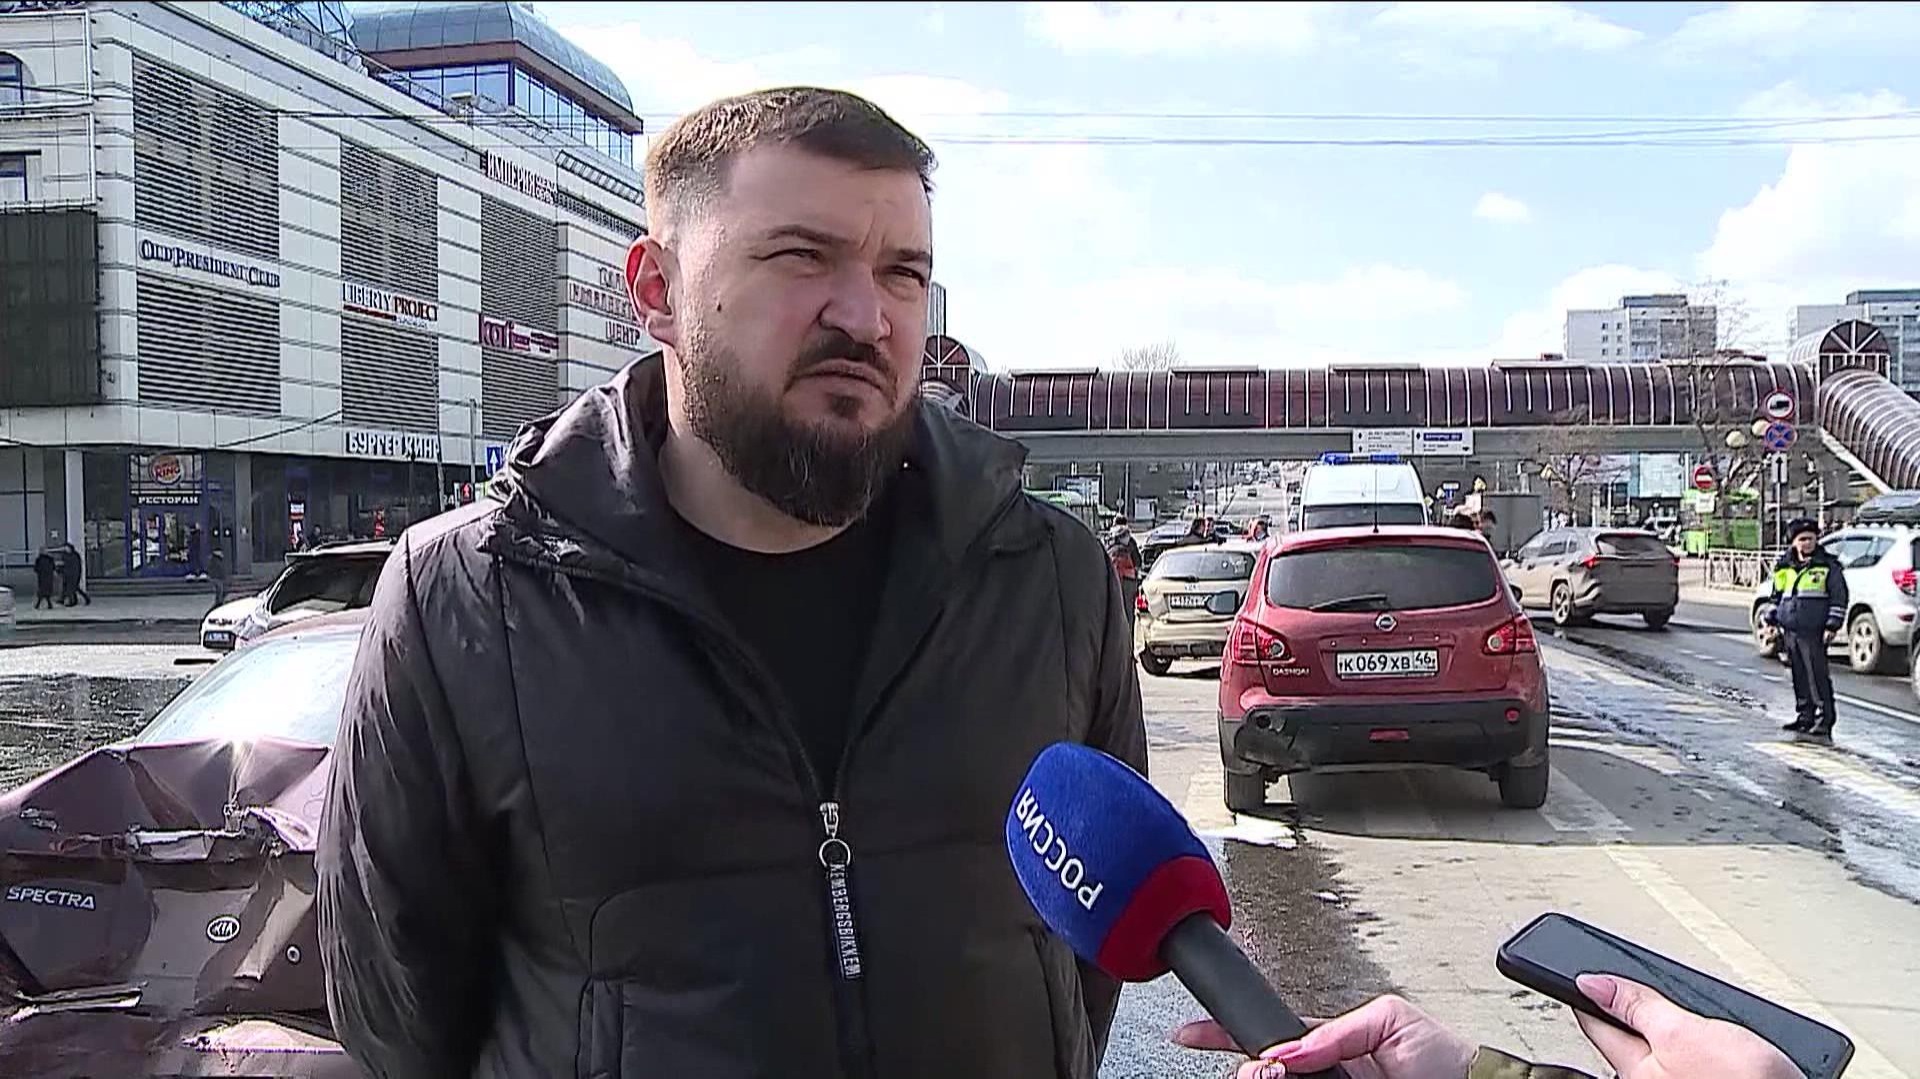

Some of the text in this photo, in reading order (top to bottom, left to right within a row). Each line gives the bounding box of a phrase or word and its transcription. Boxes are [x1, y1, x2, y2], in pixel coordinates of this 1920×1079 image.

[487, 150, 536, 196] ИМПЕРИЯ
[139, 239, 280, 288] OLD PRESIDENT CLUB
[343, 282, 438, 322] LIBERTY PROJECT
[605, 321, 641, 345] ЦЕНТР
[347, 432, 400, 456] БУРГЕР
[138, 496, 199, 505] РЕСТОРАН
[1415, 652, 1432, 664] 46
[1015, 787, 1104, 911] РОССИЯ
[6, 886, 96, 910] SPECTRA
[210, 918, 238, 939] KIA
